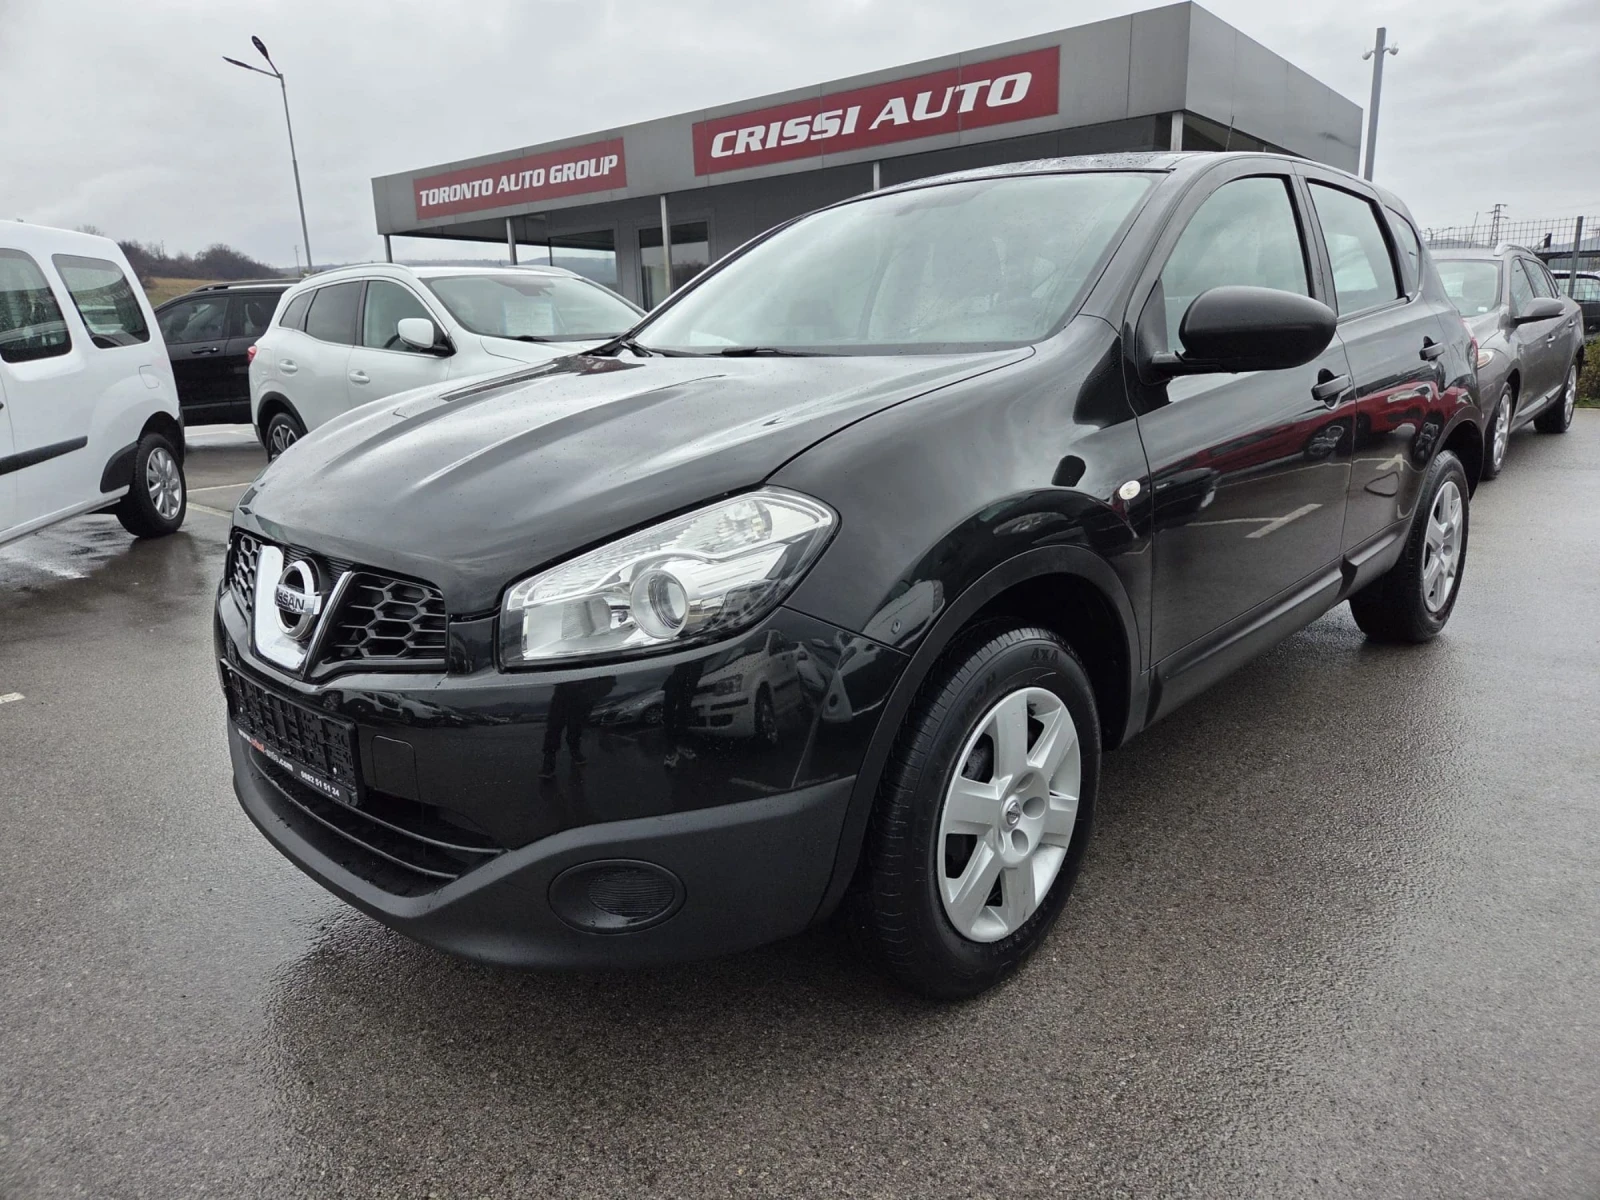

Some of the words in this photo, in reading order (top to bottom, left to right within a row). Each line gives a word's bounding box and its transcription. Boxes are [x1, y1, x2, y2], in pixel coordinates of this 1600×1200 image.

[710, 105, 862, 159] CRISSI
[868, 71, 1033, 131] AUTO
[419, 177, 494, 207] TORONTO
[496, 168, 545, 194] AUTO
[549, 154, 618, 184] GROUP
